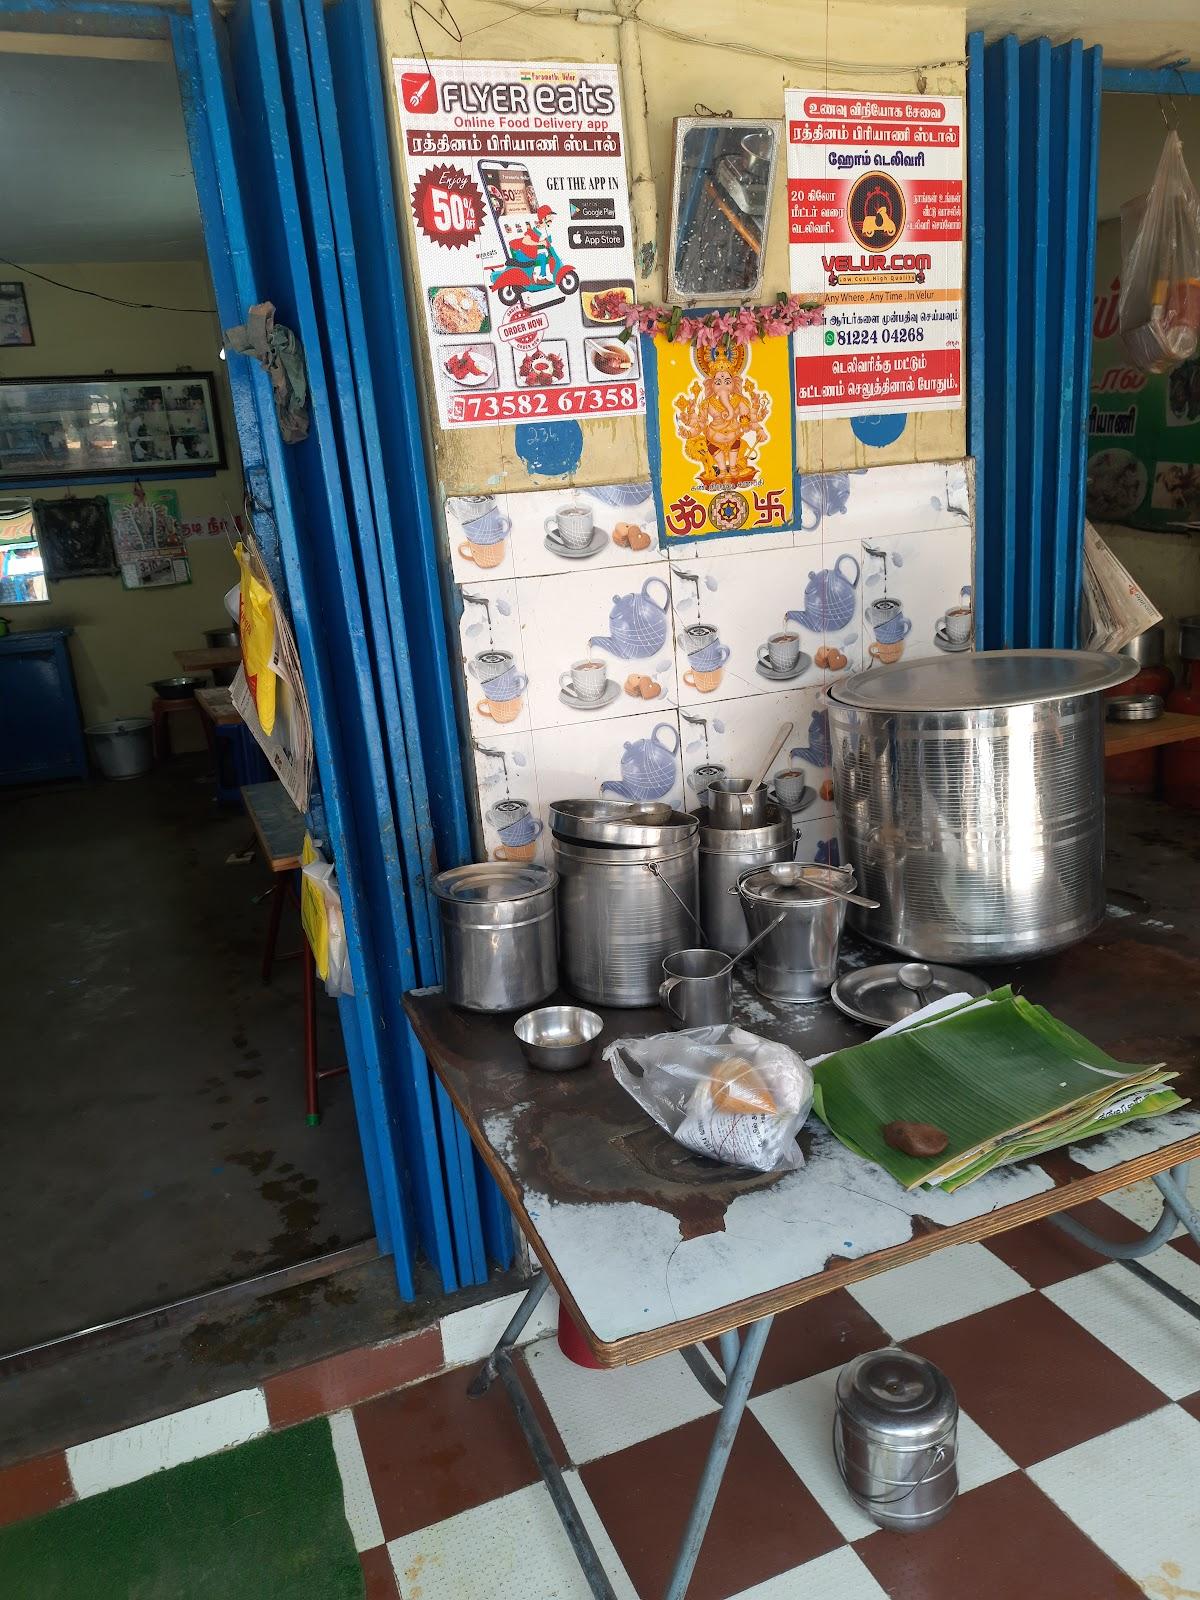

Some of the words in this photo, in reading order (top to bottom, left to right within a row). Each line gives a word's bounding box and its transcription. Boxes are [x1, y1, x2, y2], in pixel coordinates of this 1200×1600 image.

[442, 82, 529, 114] FLYER
[534, 79, 615, 115] eats
[809, 102, 847, 118] உணவு
[849, 102, 903, 119] விநியோக
[905, 105, 941, 119] சேவை
[454, 117, 495, 128] Online
[499, 117, 529, 129] Food
[534, 117, 583, 131] Delivery
[587, 120, 609, 132] app
[793, 125, 849, 143] ரத்தினம்
[852, 127, 910, 143] பிரியாணி
[914, 127, 957, 143] ஸ்டால்
[412, 133, 482, 154] ரத்தினம்
[487, 134, 560, 152] பிரியாணி
[563, 134, 617, 153] ஸ்டால்
[828, 150, 871, 170] ஹோம்
[874, 150, 925, 167] டெலிவரி
[439, 171, 468, 189] Enjoy
[546, 177, 564, 191] GET
[567, 177, 587, 190] THE
[588, 177, 606, 190] APP
[608, 177, 619, 190] IN
[791, 190, 804, 202] 20
[807, 189, 836, 202] கிலோ
[582, 207, 603, 218] Google
[821, 208, 844, 219] வரை
[466, 220, 476, 229] OFF
[584, 236, 600, 246] App
[601, 235, 621, 244] Store
[821, 254, 931, 272] VELUR.COM
[824, 293, 839, 304] Any
[839, 293, 864, 301] Where
[869, 292, 883, 303] Any
[885, 292, 902, 301] Time
[907, 291, 915, 299] In
[915, 291, 934, 299] Velur
[829, 313, 880, 327] ஆர்டர்களை
[882, 311, 918, 326] முன்பதிவு
[920, 309, 959, 322] செய்யவும்
[503, 324, 527, 337] ORDER
[527, 318, 543, 330] NOW
[837, 330, 878, 346] 81224
[882, 327, 924, 343] 04268
[831, 355, 891, 374] டெலிவரிக்கு
[894, 353, 928, 372] மட்டும்
[799, 380, 845, 399] கட்டணம்
[848, 375, 915, 399] செலுத்தினால்
[469, 393, 549, 417] 73582
[558, 388, 634, 411] 67358
